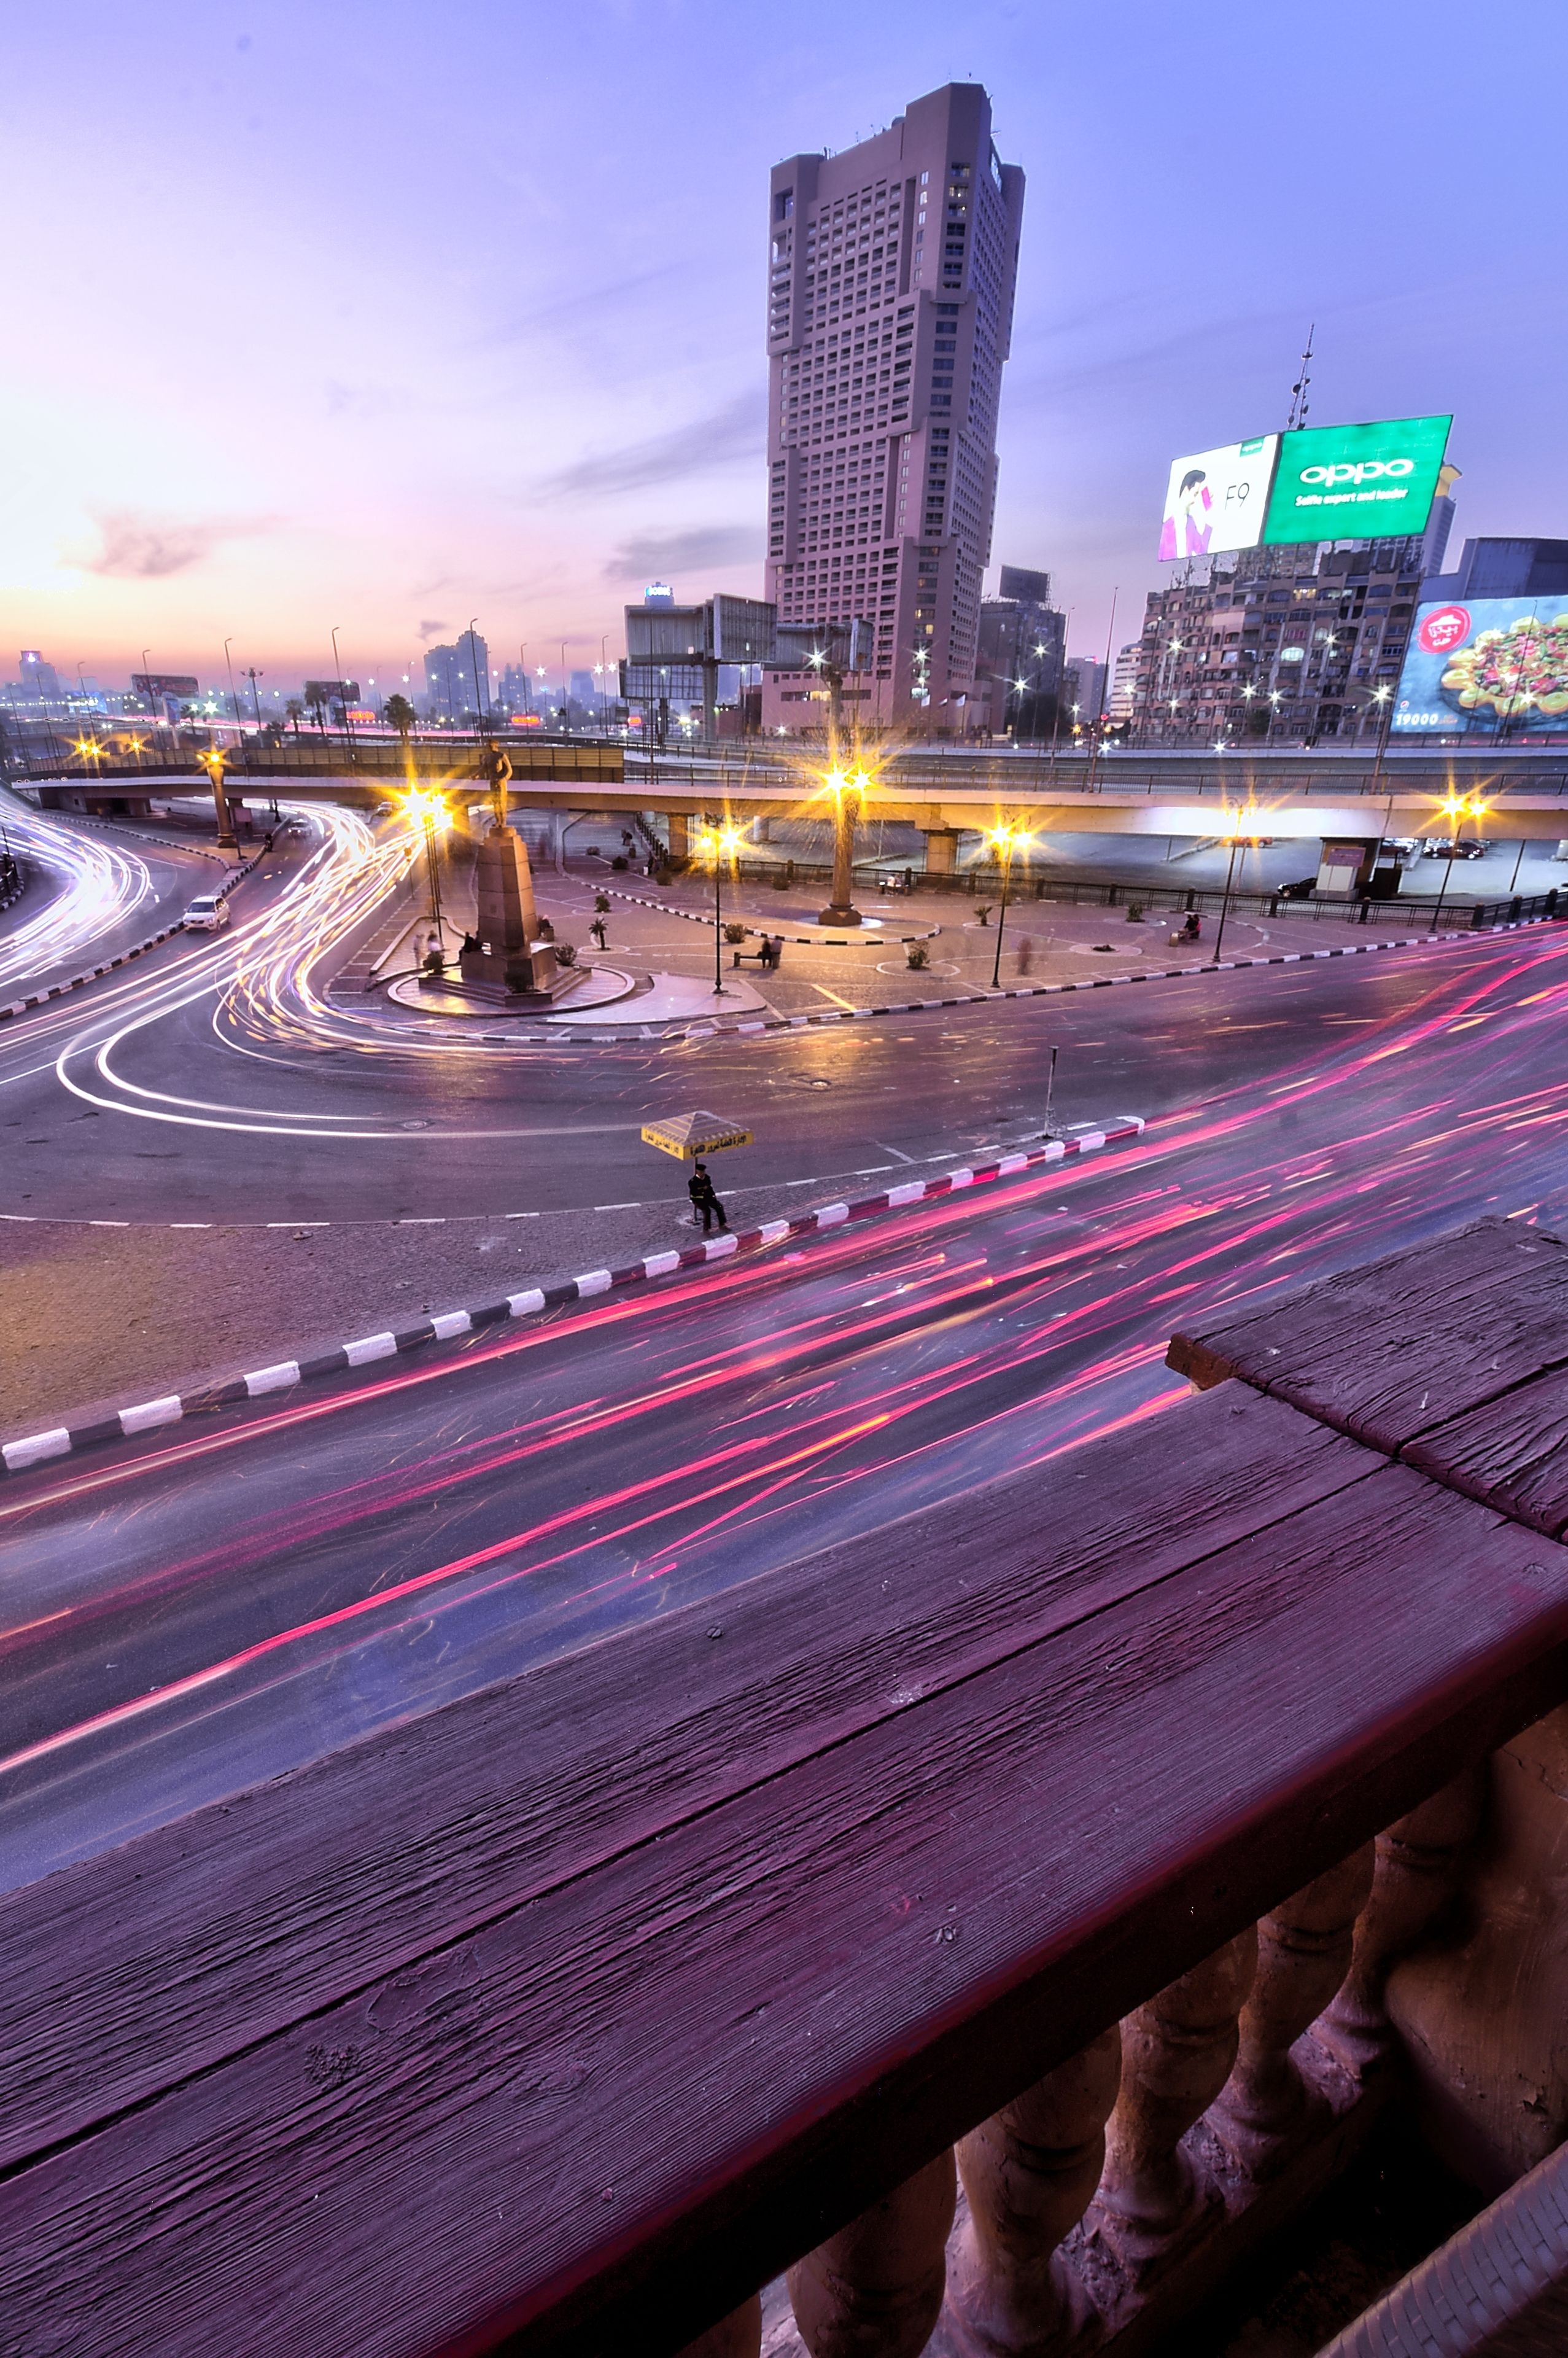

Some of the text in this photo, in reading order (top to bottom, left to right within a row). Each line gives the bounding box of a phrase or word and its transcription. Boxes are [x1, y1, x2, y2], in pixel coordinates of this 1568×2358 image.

[1300, 459, 1414, 487] oppo
[1225, 482, 1250, 510] F9
[1323, 492, 1357, 505] expert
[1356, 490, 1376, 502] and
[1376, 488, 1408, 500] leader
[1428, 625, 1458, 638] بيتزا
[1396, 713, 1438, 725] 19000
